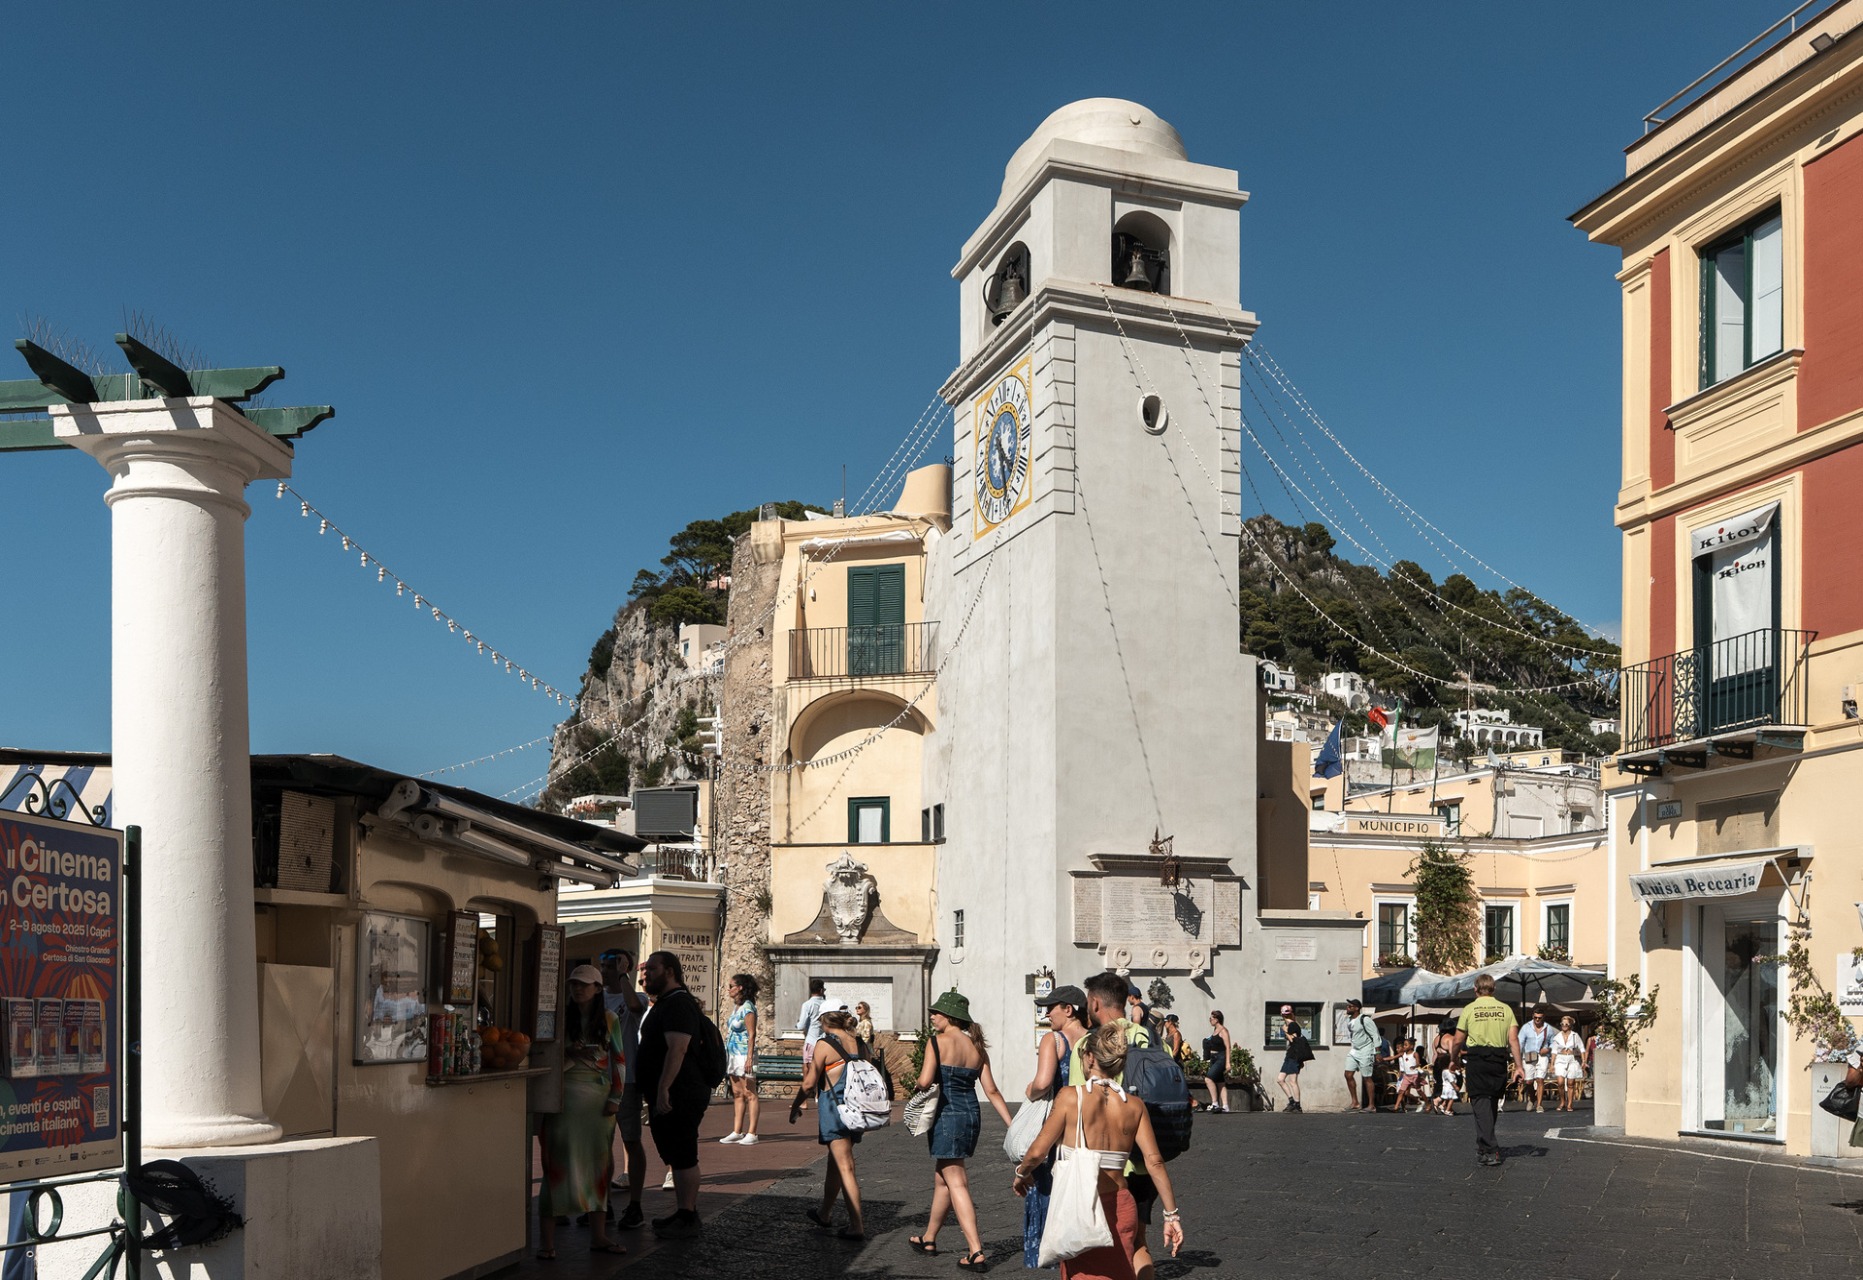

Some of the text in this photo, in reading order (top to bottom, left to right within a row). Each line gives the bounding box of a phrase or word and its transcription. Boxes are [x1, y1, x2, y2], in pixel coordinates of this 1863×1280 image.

[1719, 561, 1766, 580] Kiton
[1359, 820, 1429, 833] MUNICIPIO
[20, 839, 111, 882] Cinema
[1637, 873, 1756, 896] Luisa Beccaria
[12, 875, 111, 915] Certosa
[31, 923, 61, 935] agosto
[62, 923, 85, 935] 2025
[90, 926, 111, 939] Capri
[662, 933, 710, 946] FUNICOLARE
[65, 944, 111, 955] Chiostro Grande
[43, 953, 111, 964] Certosa di San Giacomo
[675, 953, 705, 963] NTRATA
[681, 964, 708, 973] RANCE
[1474, 1011, 1505, 1019] SEGUICI
[8, 1099, 42, 1116] eventi
[43, 1101, 51, 1112] e
[52, 1097, 81, 1114] ospiti
[0, 1120, 40, 1136] cinema
[41, 1116, 79, 1131] italiano
